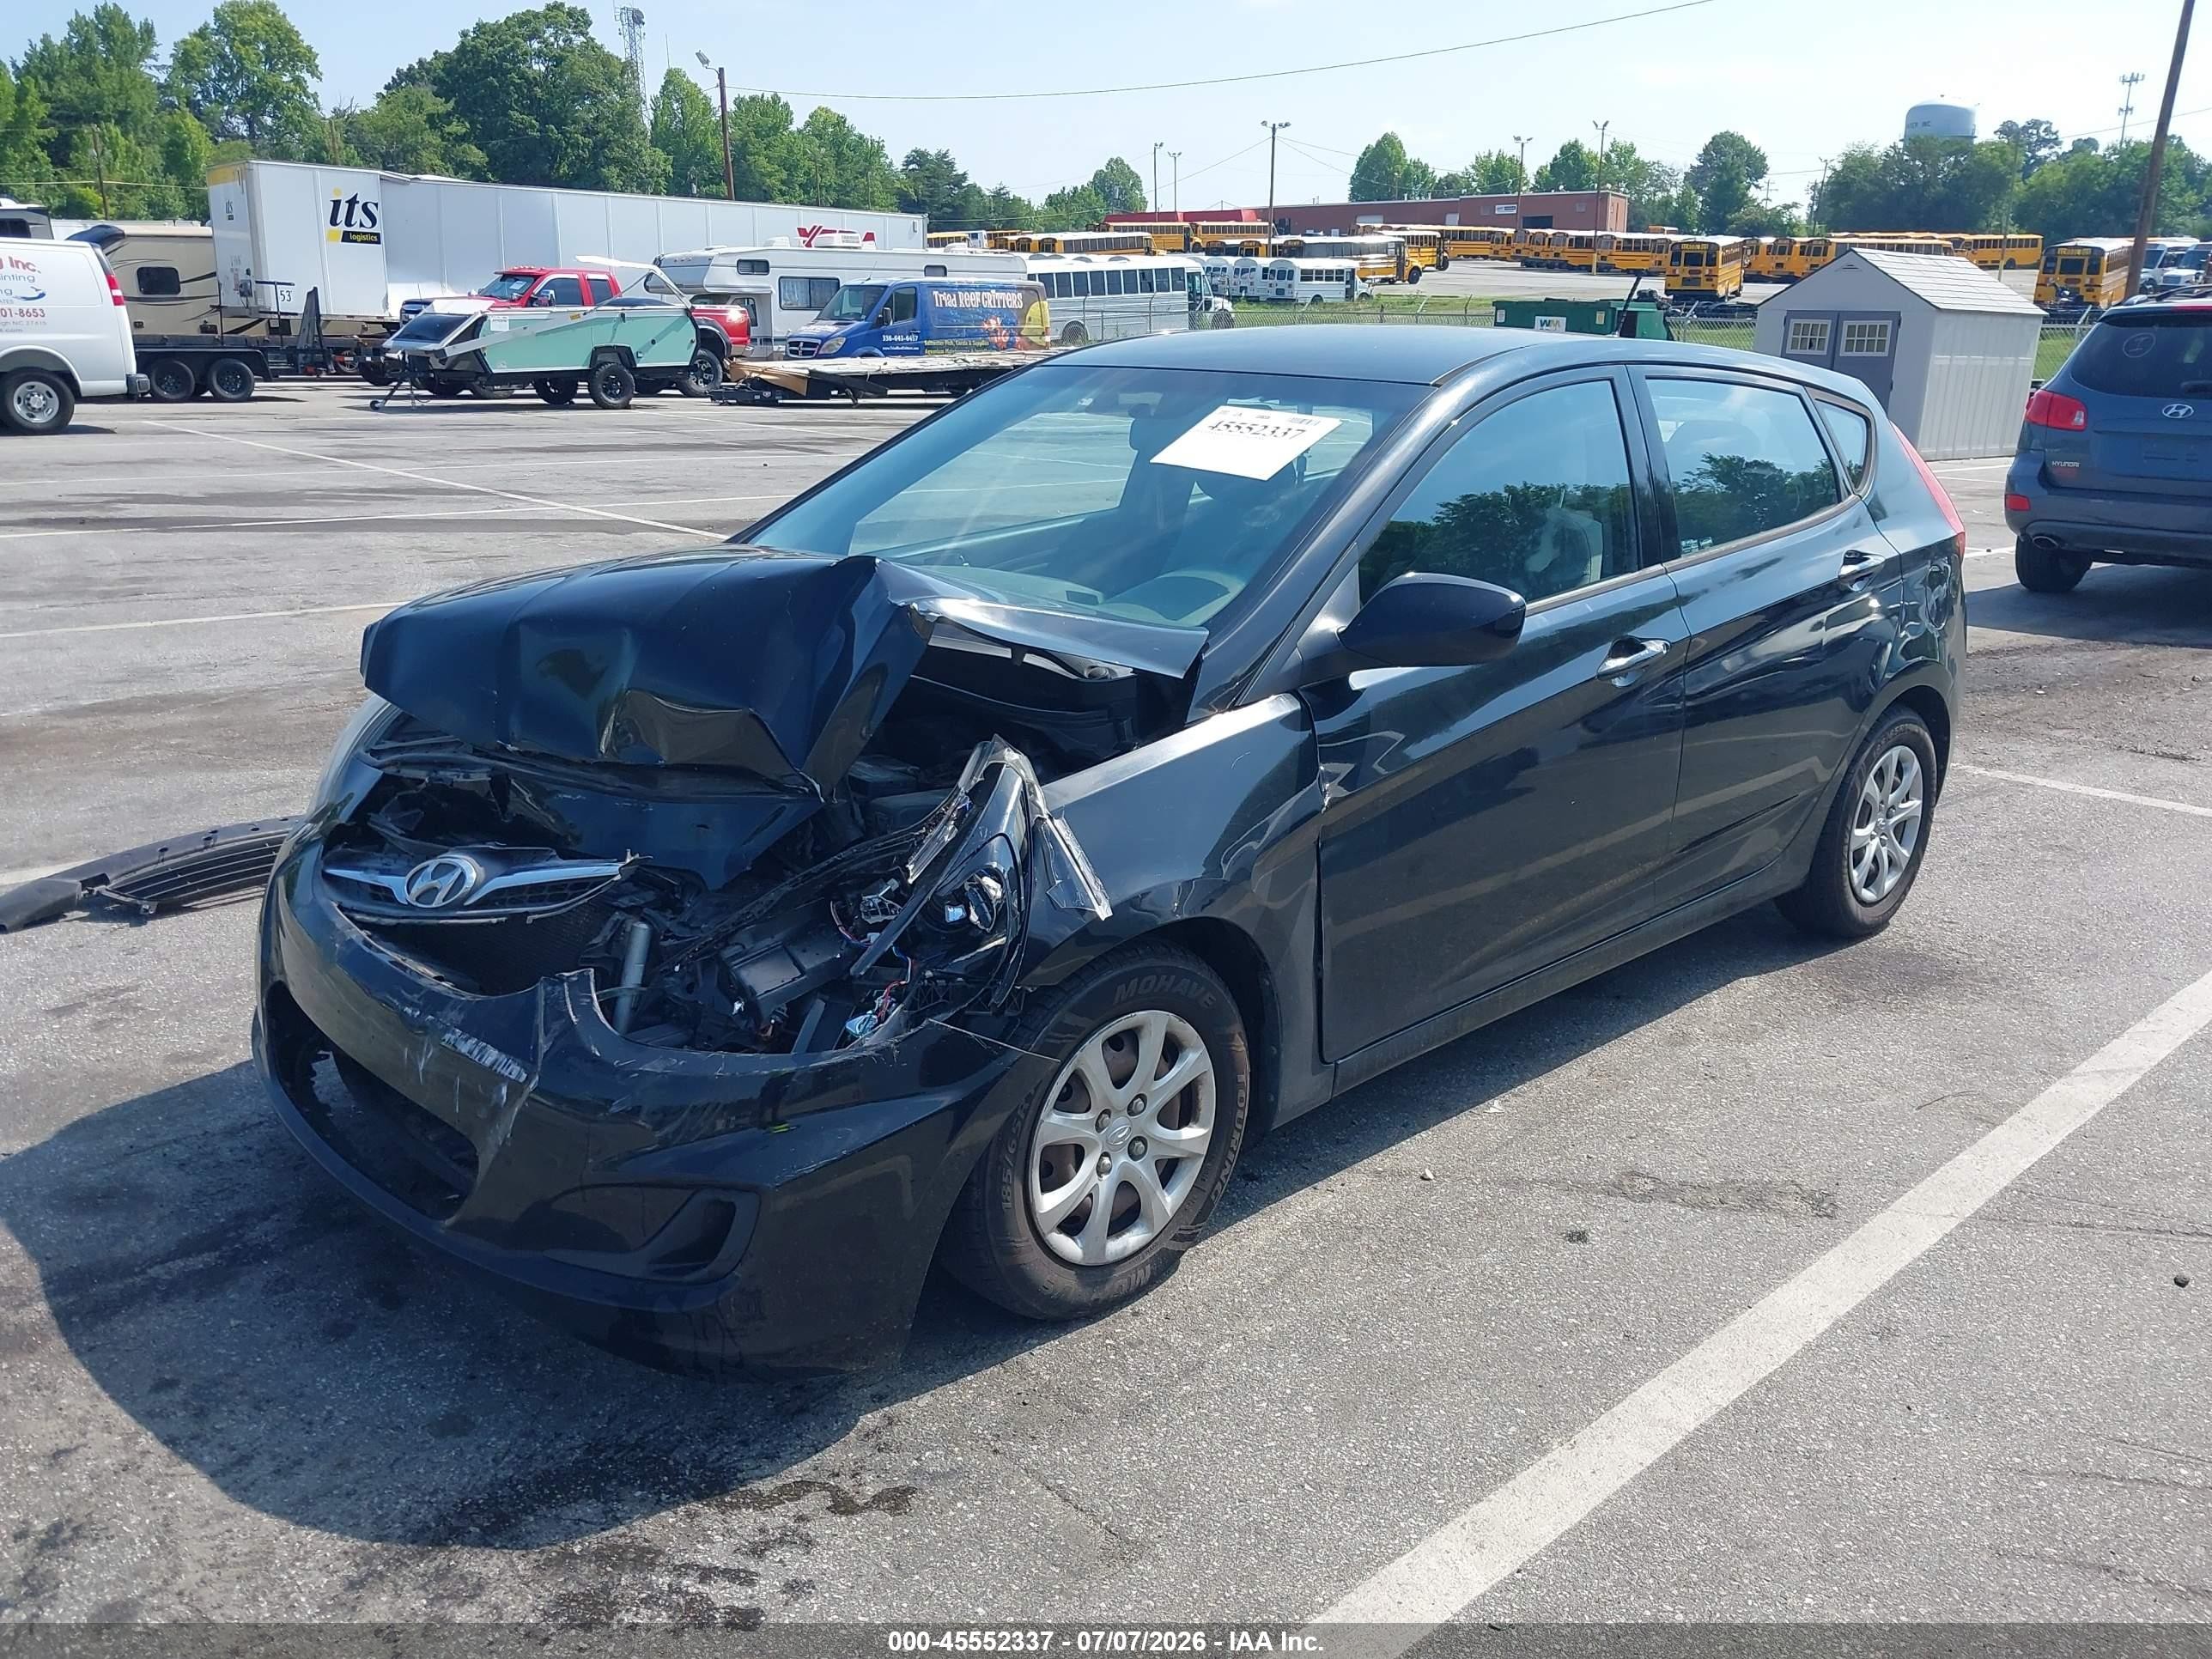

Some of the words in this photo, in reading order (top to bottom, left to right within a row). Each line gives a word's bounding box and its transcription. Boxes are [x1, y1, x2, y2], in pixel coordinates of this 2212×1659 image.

[329, 186, 379, 229] its
[349, 233, 378, 242] logistics
[8, 256, 41, 274] Inc.
[0, 274, 35, 283] inting
[933, 290, 957, 307] Triad
[1540, 319, 1561, 328] WM
[1114, 974, 1217, 1009] MOHAVE
